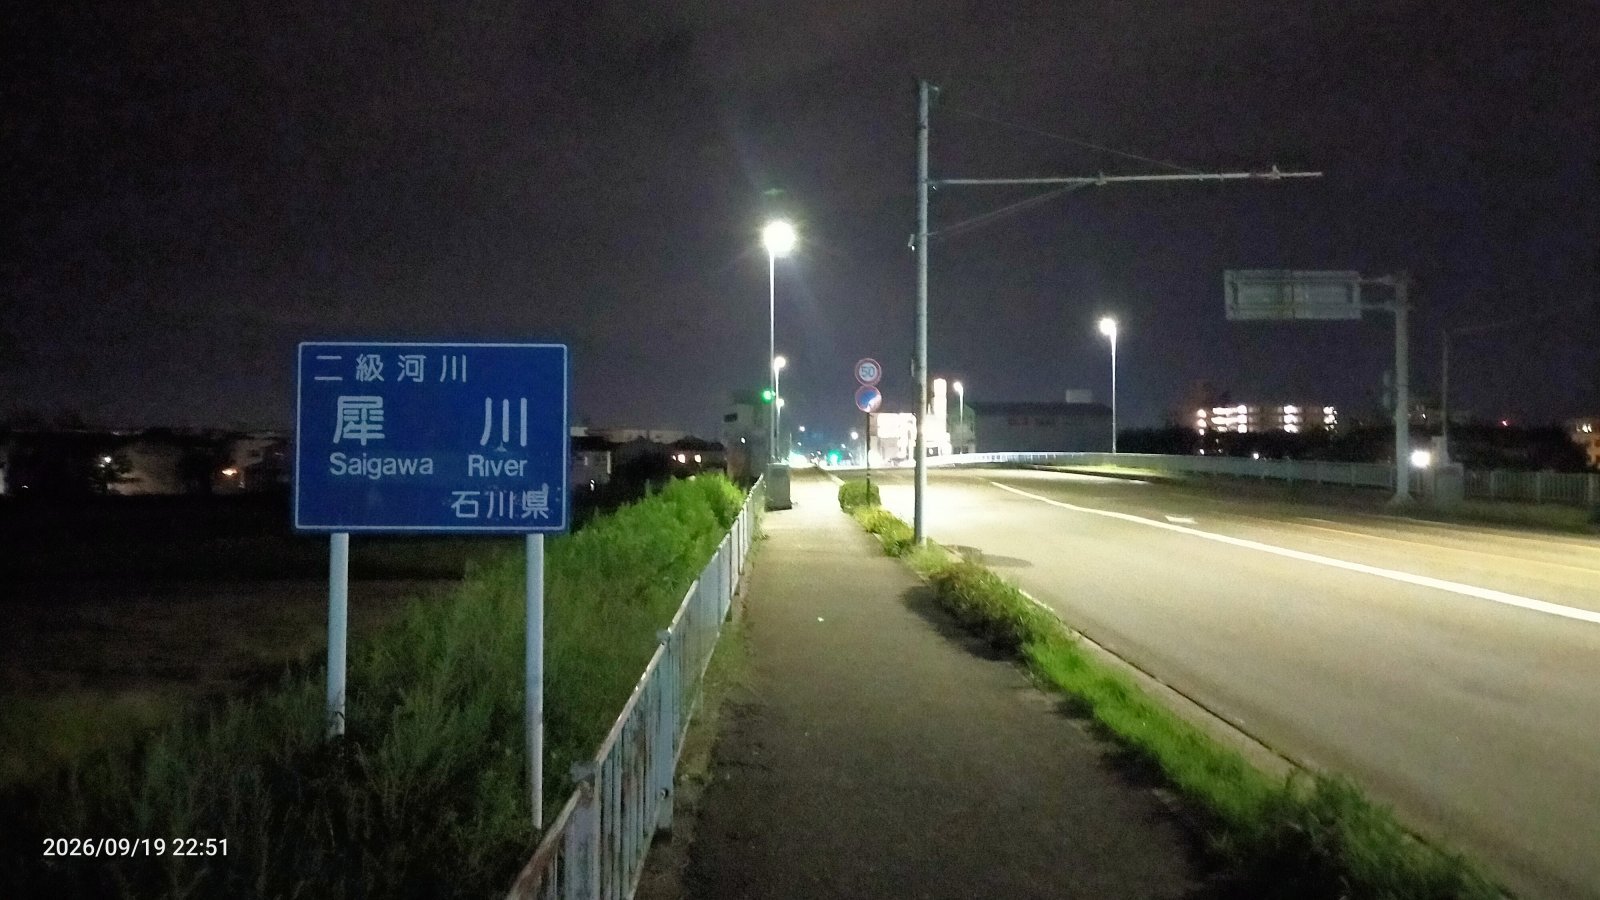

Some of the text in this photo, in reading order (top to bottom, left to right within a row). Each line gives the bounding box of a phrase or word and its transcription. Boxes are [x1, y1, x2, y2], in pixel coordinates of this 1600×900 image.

[314, 353, 468, 383] 二級河川
[861, 366, 876, 378] 50
[329, 452, 528, 480] Saigawa River
[450, 488, 549, 519] 石川県
